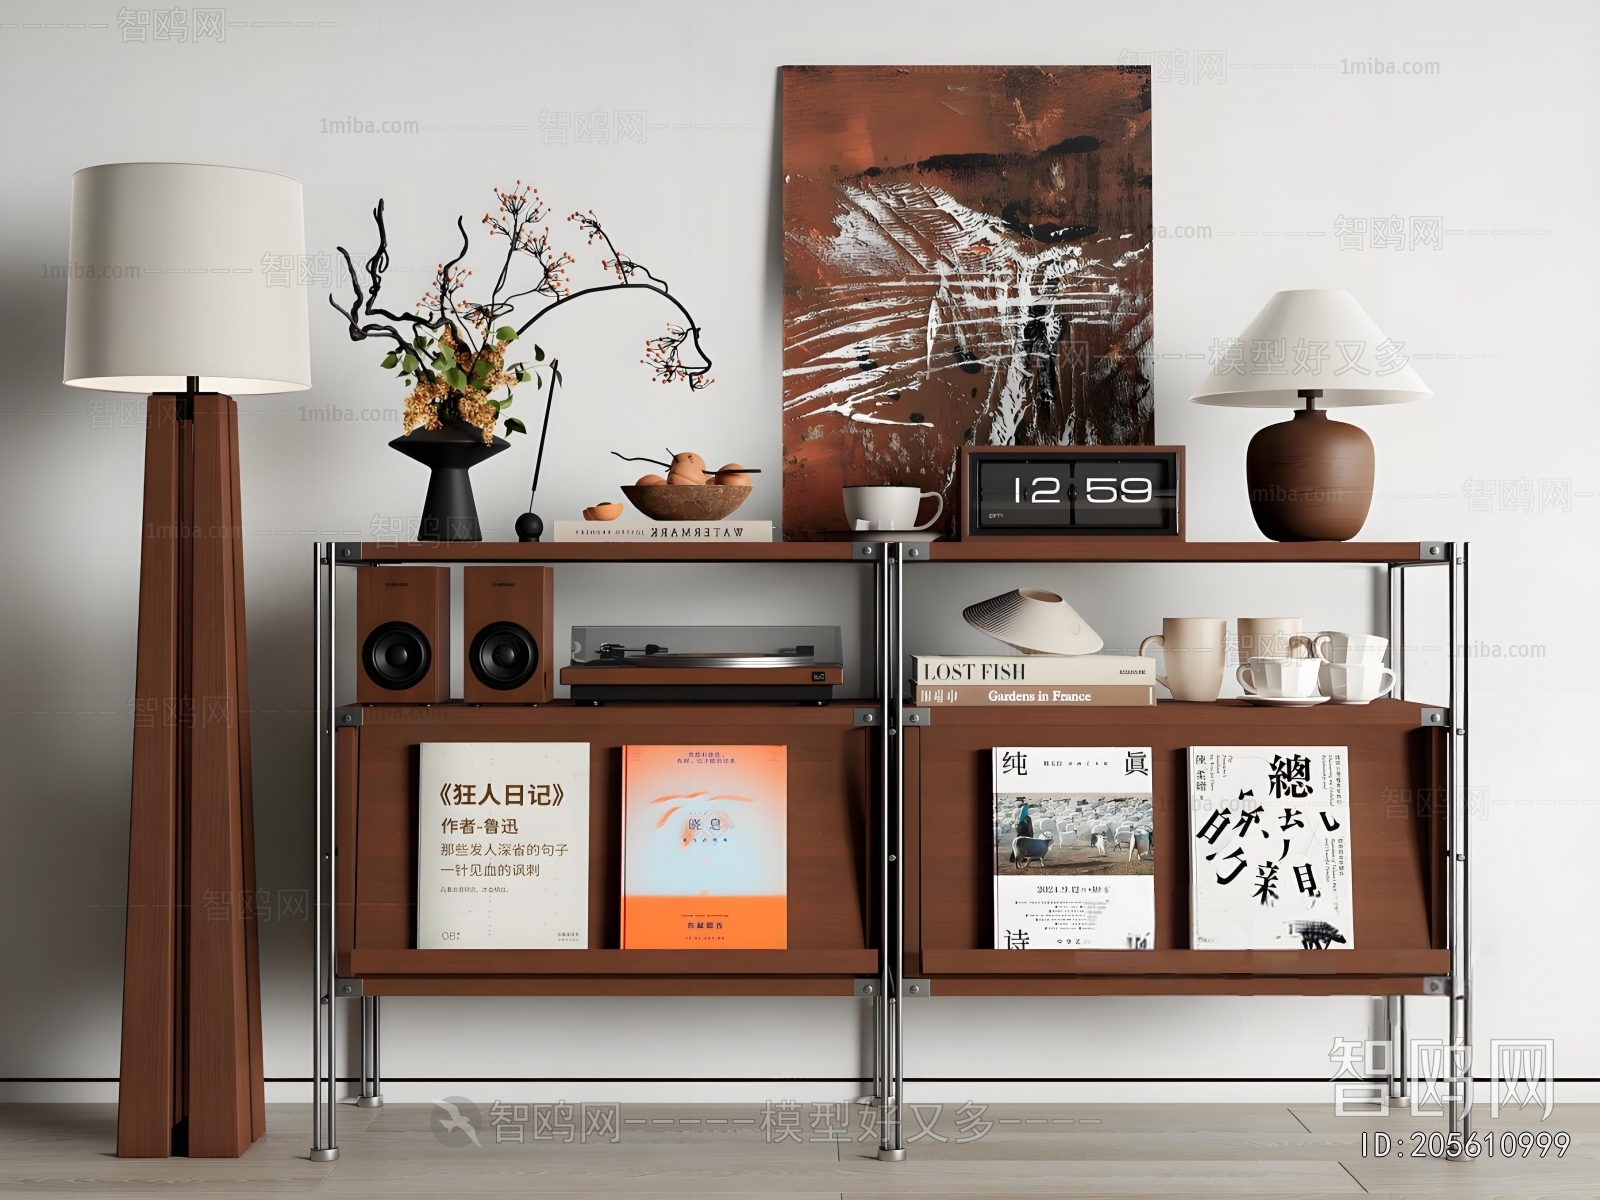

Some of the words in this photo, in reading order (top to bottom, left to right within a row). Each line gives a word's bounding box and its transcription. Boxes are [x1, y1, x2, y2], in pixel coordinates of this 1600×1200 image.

[1015, 477, 1061, 503] 12
[1086, 477, 1153, 503] 59
[923, 663, 976, 681] LOST
[981, 663, 1026, 681] FISH
[988, 690, 1035, 702] Gardens
[1037, 690, 1049, 702] in
[1052, 690, 1092, 702] France
[1002, 751, 1029, 776] 纯
[1268, 753, 1314, 799] 總
[440, 783, 564, 806] 《狂人日记》
[441, 817, 519, 835] 作者-鲁迅
[440, 843, 569, 857] 那些发人深省的句子
[440, 863, 540, 877] 一针见血的讽刺
